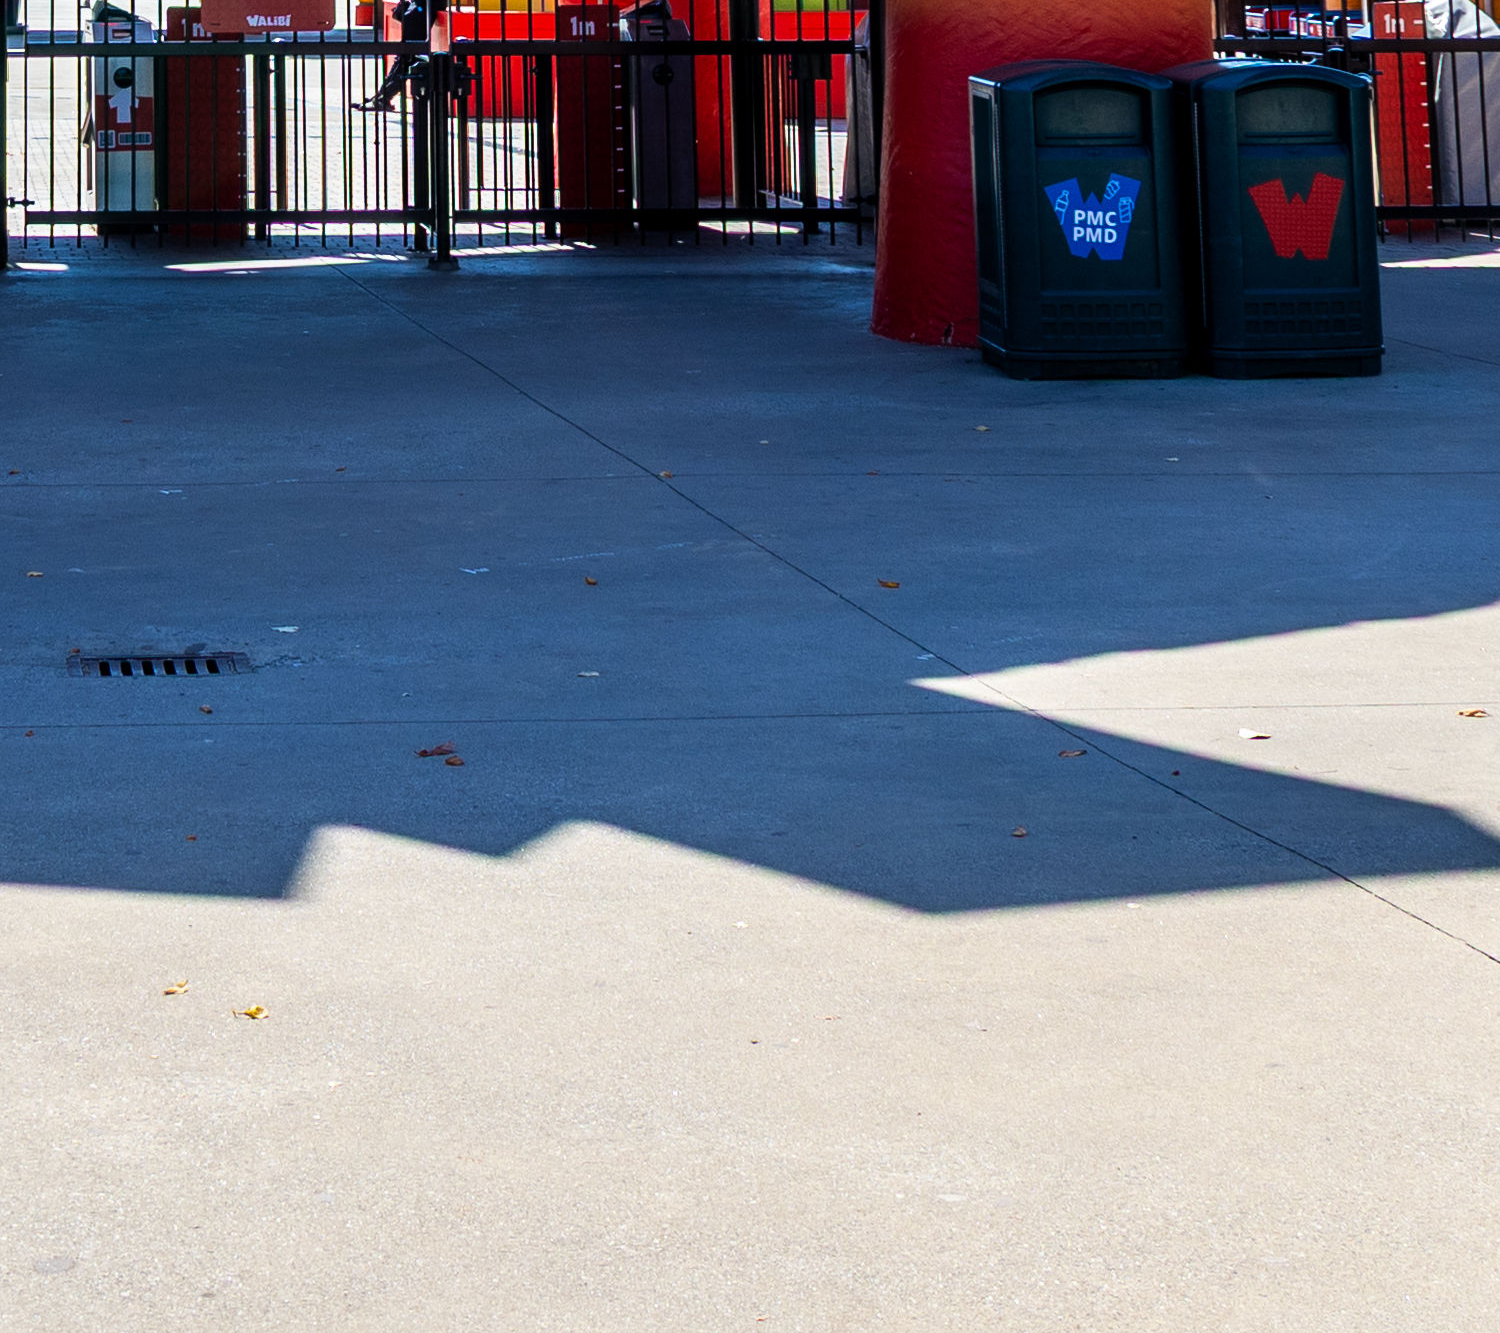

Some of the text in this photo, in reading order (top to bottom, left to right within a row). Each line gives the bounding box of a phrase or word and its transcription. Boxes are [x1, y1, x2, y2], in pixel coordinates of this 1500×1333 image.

[1073, 209, 1118, 227] PMC
[1248, 171, 1346, 261] W
[1072, 227, 1119, 244] PMD
